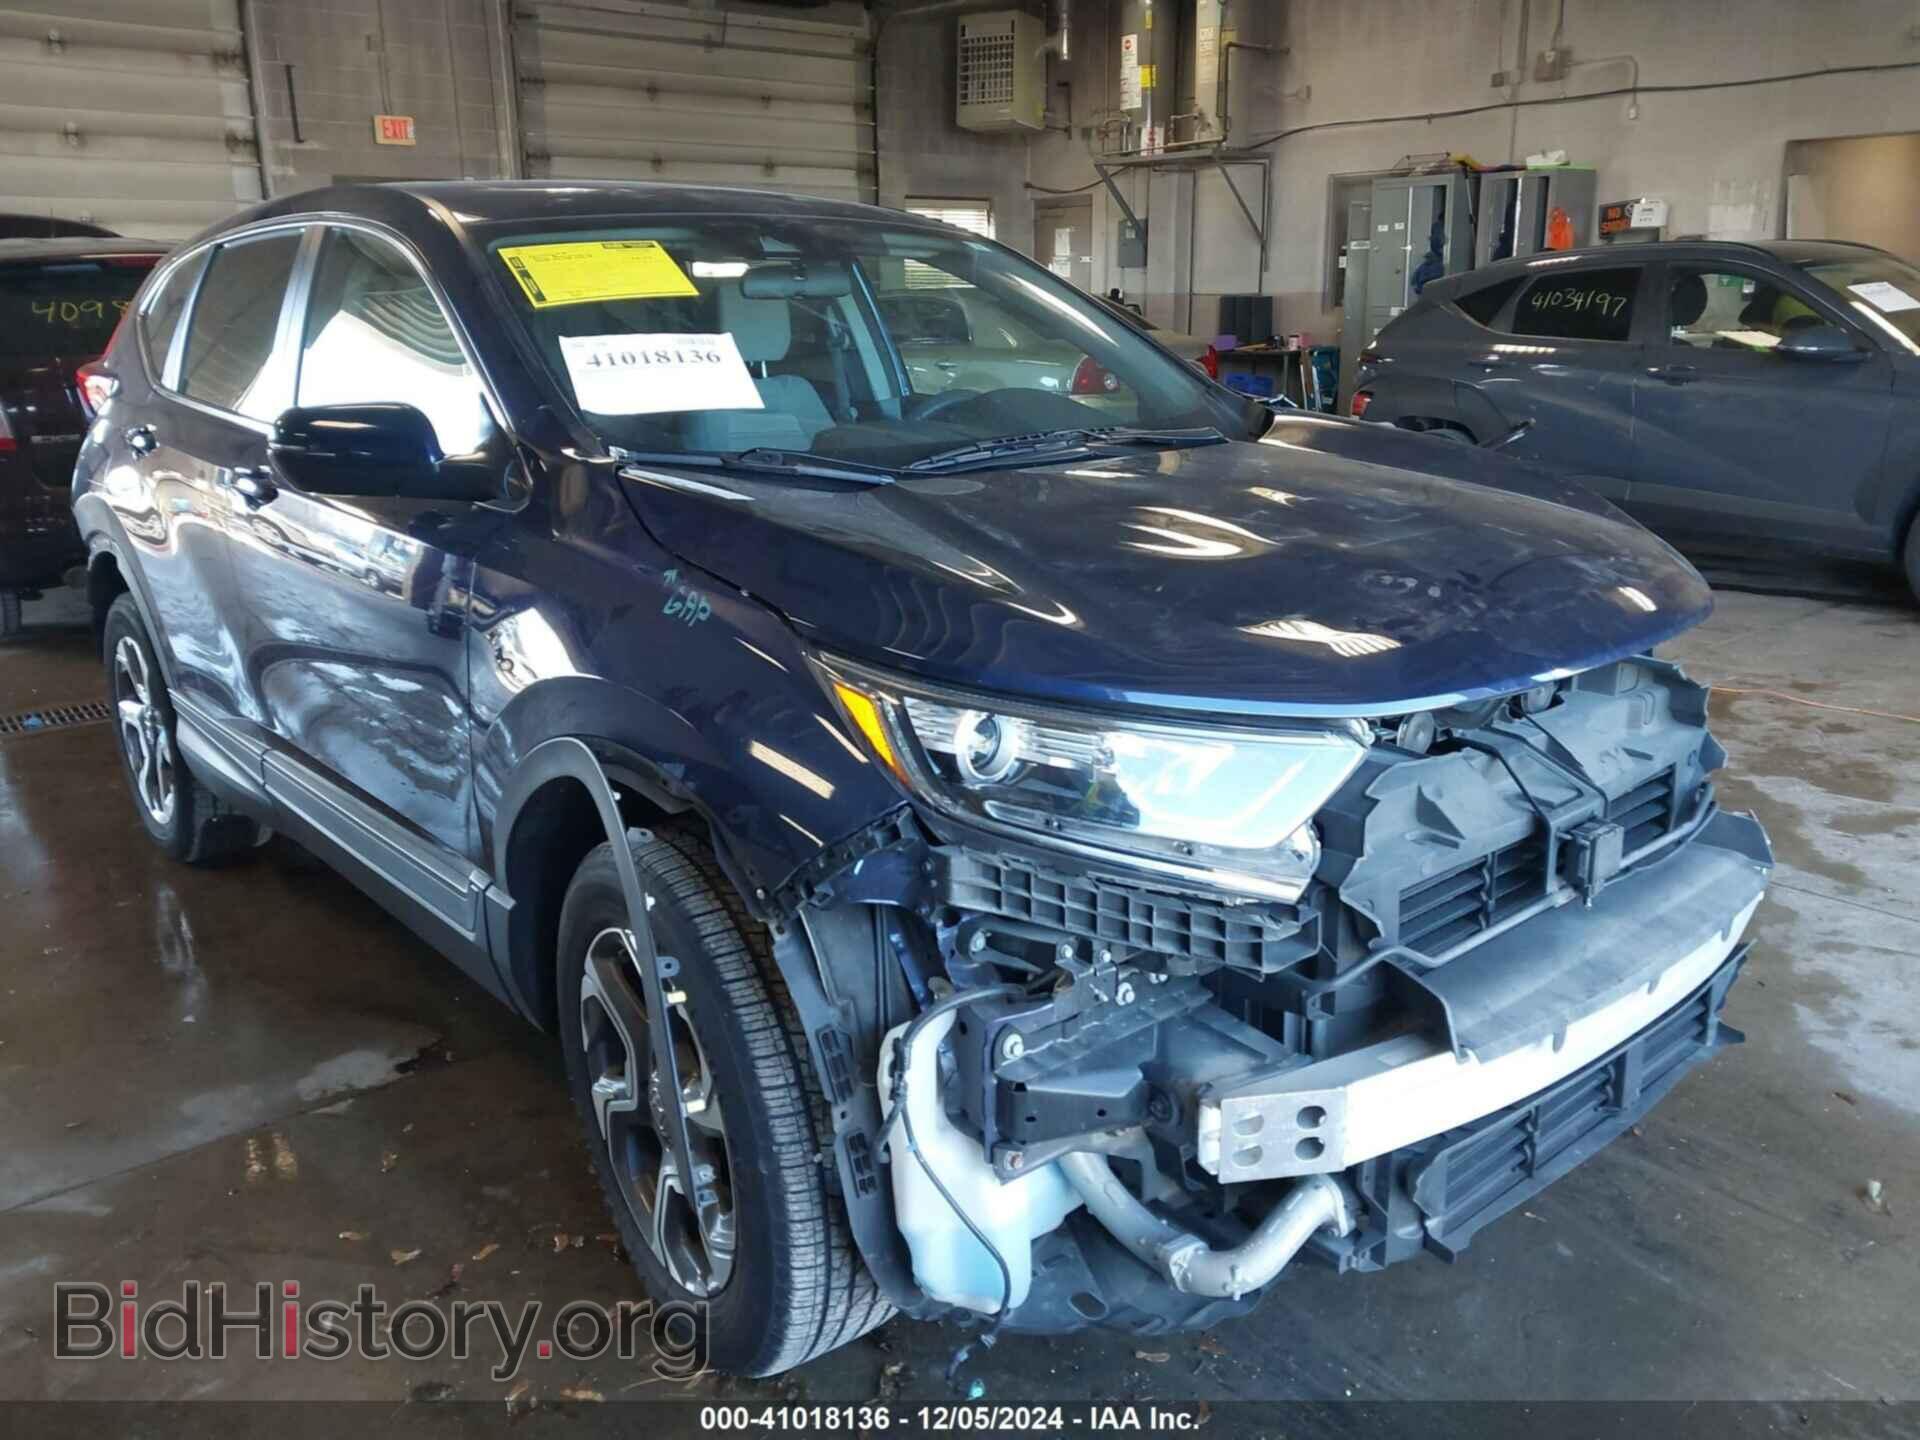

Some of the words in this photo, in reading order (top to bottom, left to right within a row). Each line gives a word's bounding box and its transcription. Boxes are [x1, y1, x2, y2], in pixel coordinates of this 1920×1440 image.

[383, 119, 409, 139] EXIT
[1531, 287, 1628, 317] 41034197
[585, 350, 722, 368] 41018136
